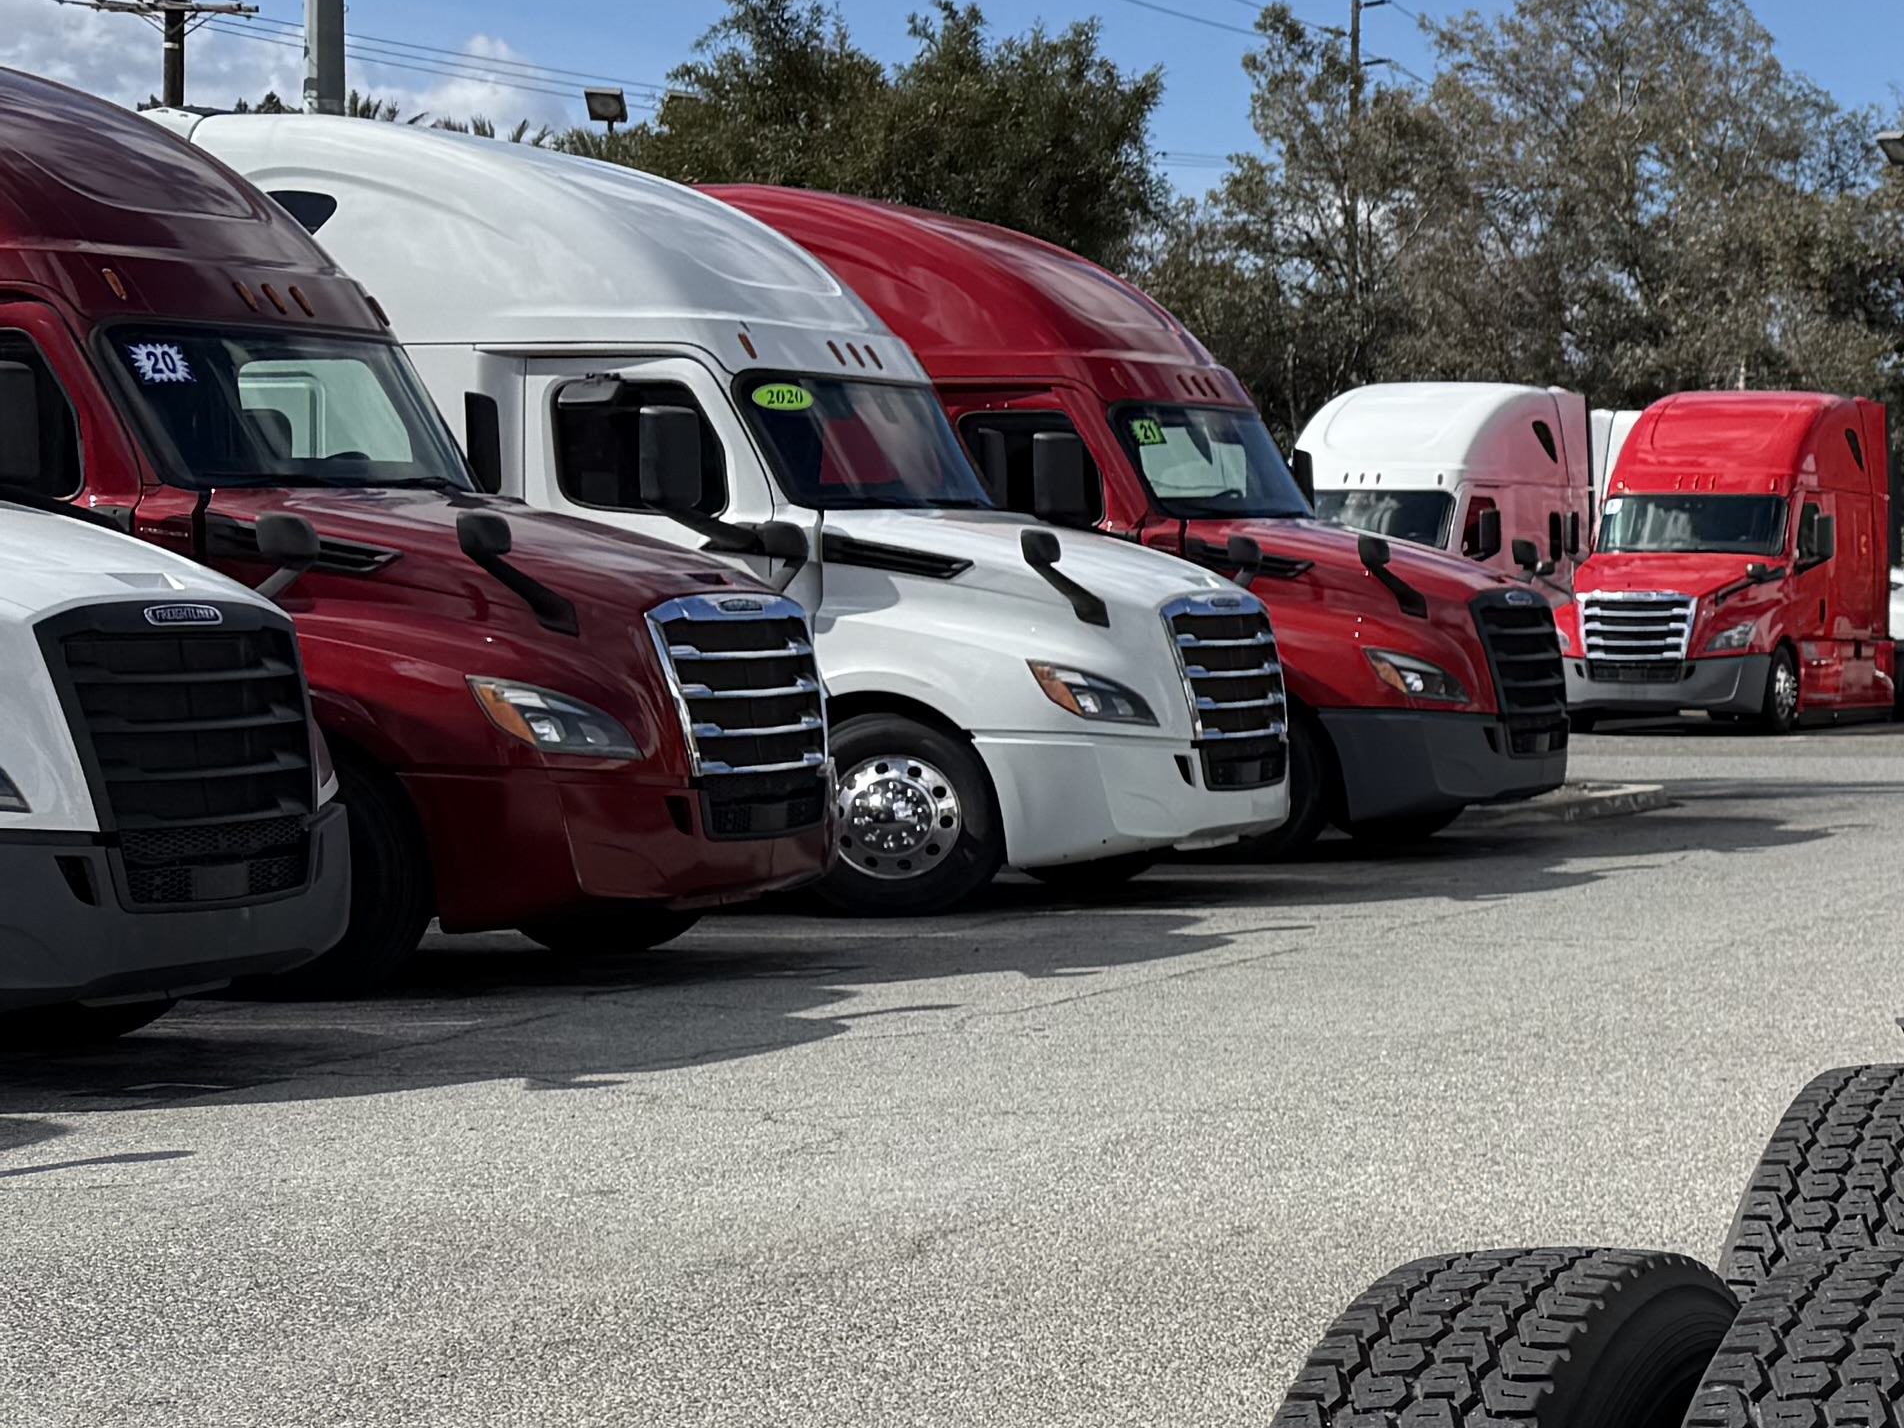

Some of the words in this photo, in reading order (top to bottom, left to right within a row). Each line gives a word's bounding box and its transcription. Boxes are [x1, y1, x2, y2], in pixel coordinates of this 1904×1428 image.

[145, 350, 178, 375] 20
[766, 388, 804, 406] 2020
[1139, 422, 1157, 440] 21
